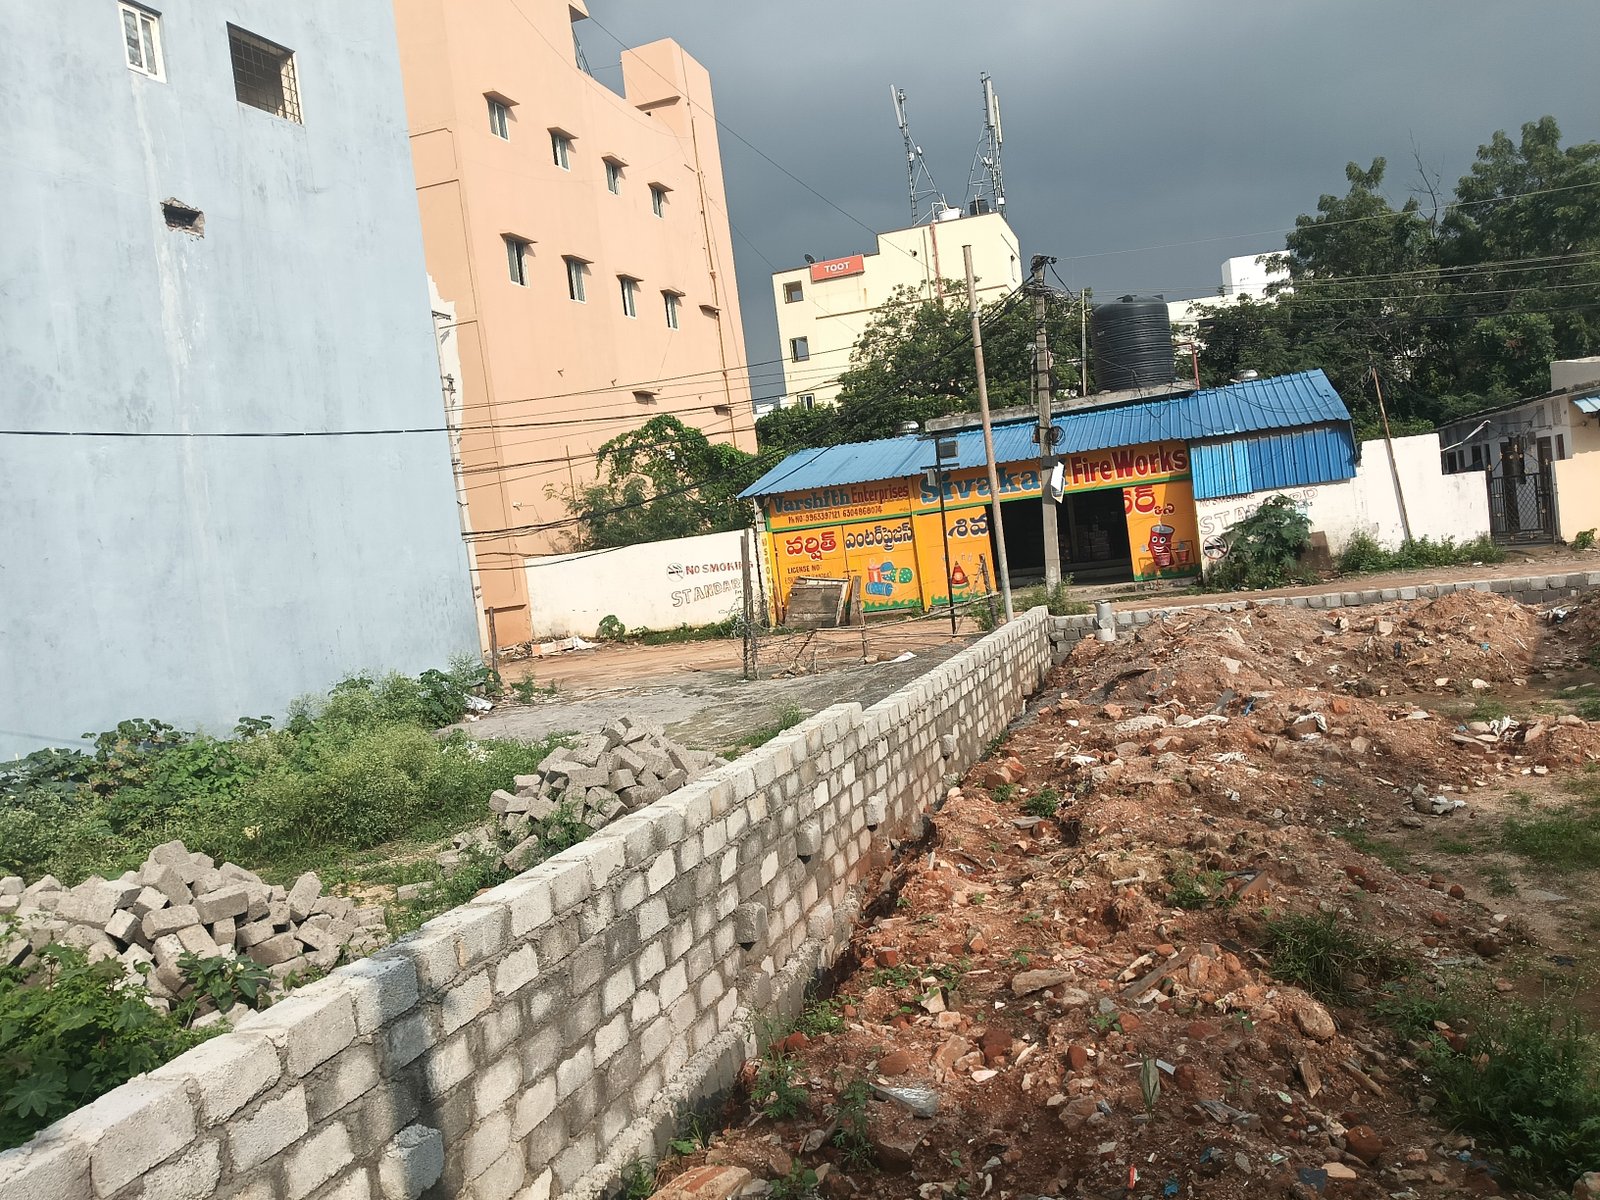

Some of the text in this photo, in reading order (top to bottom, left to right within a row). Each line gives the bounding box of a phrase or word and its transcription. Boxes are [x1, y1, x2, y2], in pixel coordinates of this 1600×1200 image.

[824, 261, 850, 273] TOOT
[920, 464, 1068, 504] Sivaka
[772, 484, 909, 514] Varshith Enterprises
[685, 565, 700, 576] NO
[787, 565, 810, 575] LICENSE
[671, 578, 743, 608] STANDAR
